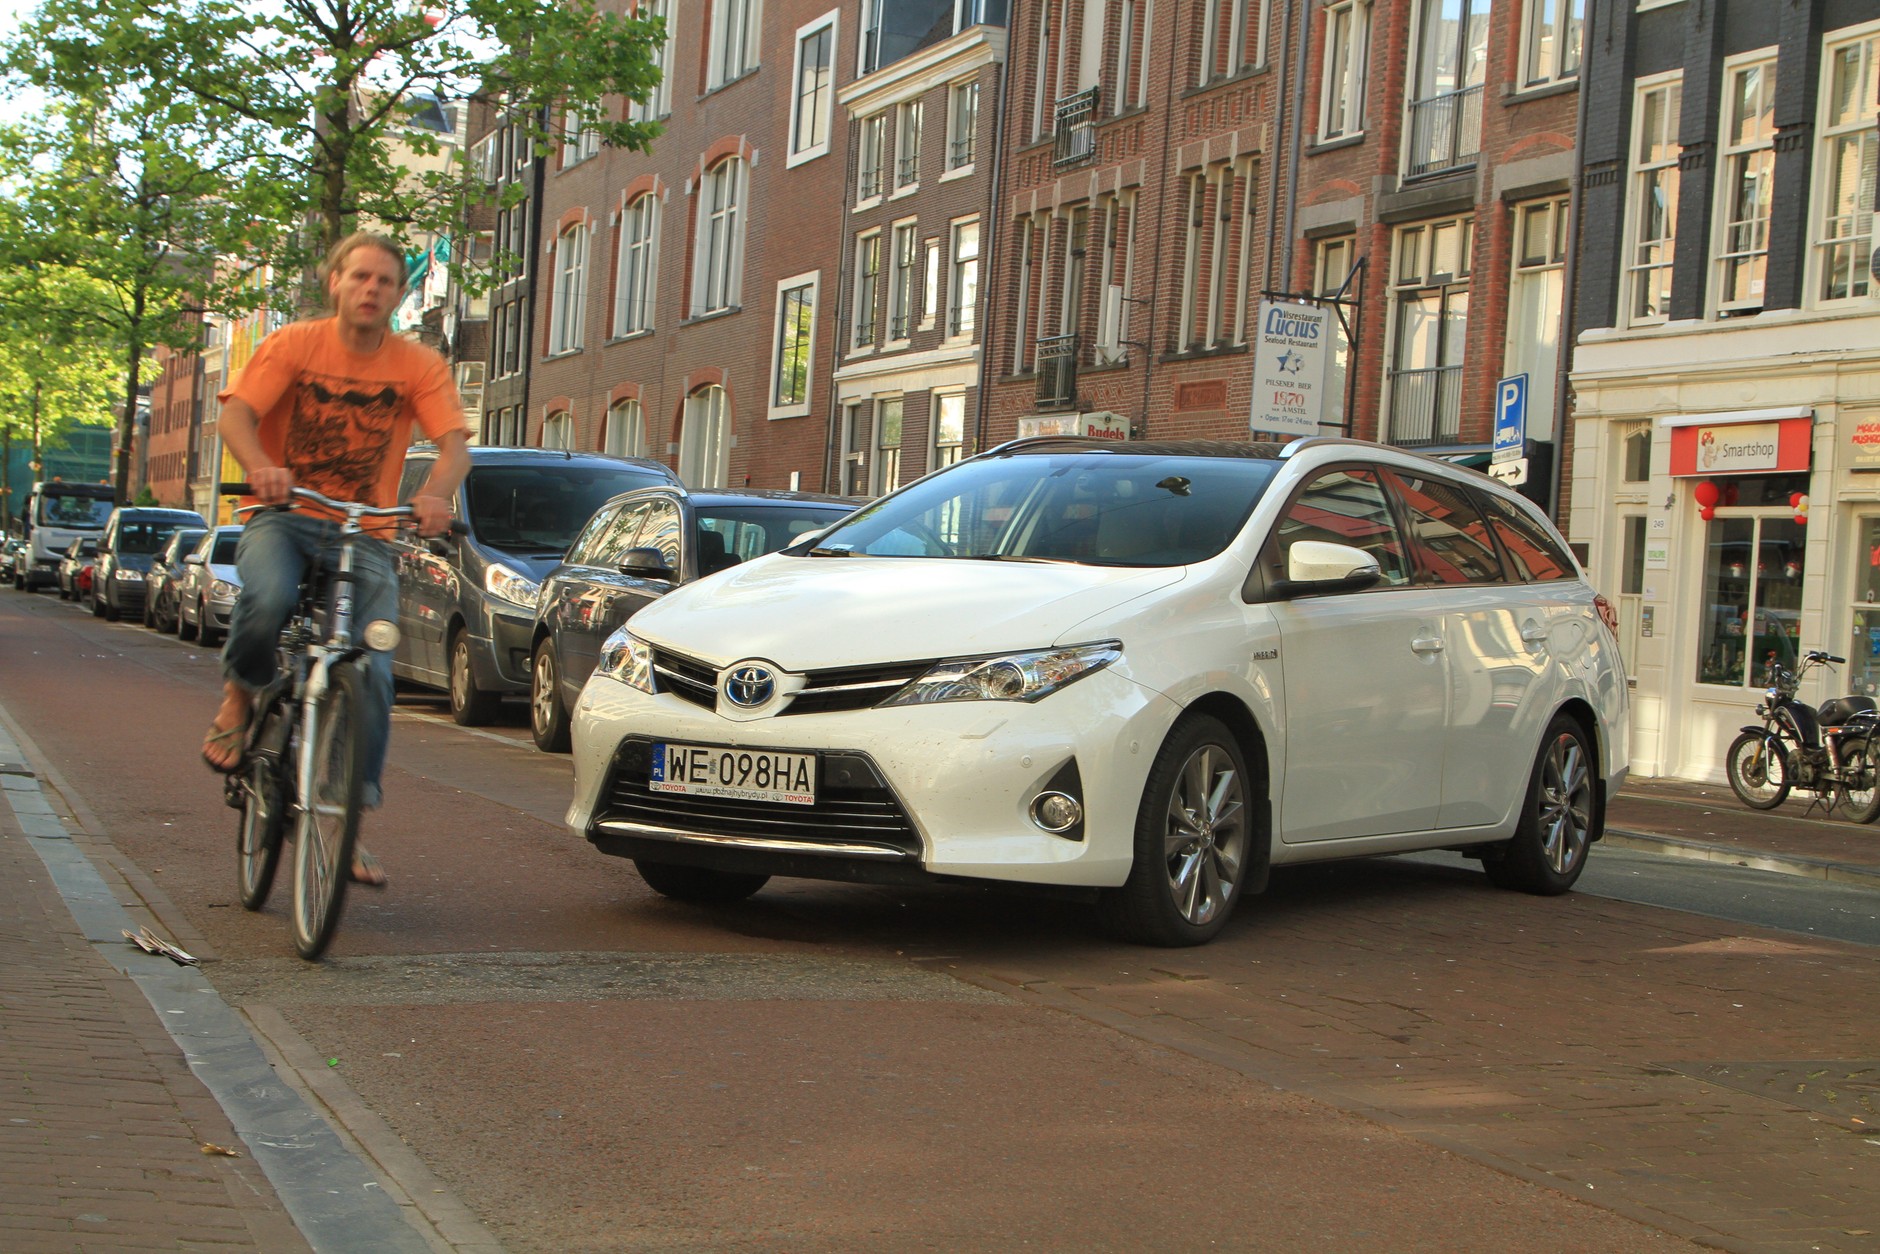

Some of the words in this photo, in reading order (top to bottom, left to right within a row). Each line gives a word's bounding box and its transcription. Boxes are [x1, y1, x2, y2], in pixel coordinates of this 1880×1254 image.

[1284, 311, 1322, 323] Visrestaurant
[1265, 308, 1319, 339] Lucius
[1264, 336, 1286, 345] Seafood
[1288, 338, 1318, 348] Restaurant
[1266, 379, 1294, 388] PILSENER
[1273, 391, 1304, 407] 1870
[1501, 383, 1519, 420] P
[1088, 425, 1124, 440] Budels
[1723, 442, 1774, 459] Smartshop
[1653, 520, 1665, 528] 249
[653, 768, 663, 777] PL
[670, 748, 708, 783] WE
[719, 752, 810, 792] 098HA
[662, 783, 687, 793] TOYOTA
[784, 794, 812, 803] TOYOTA
